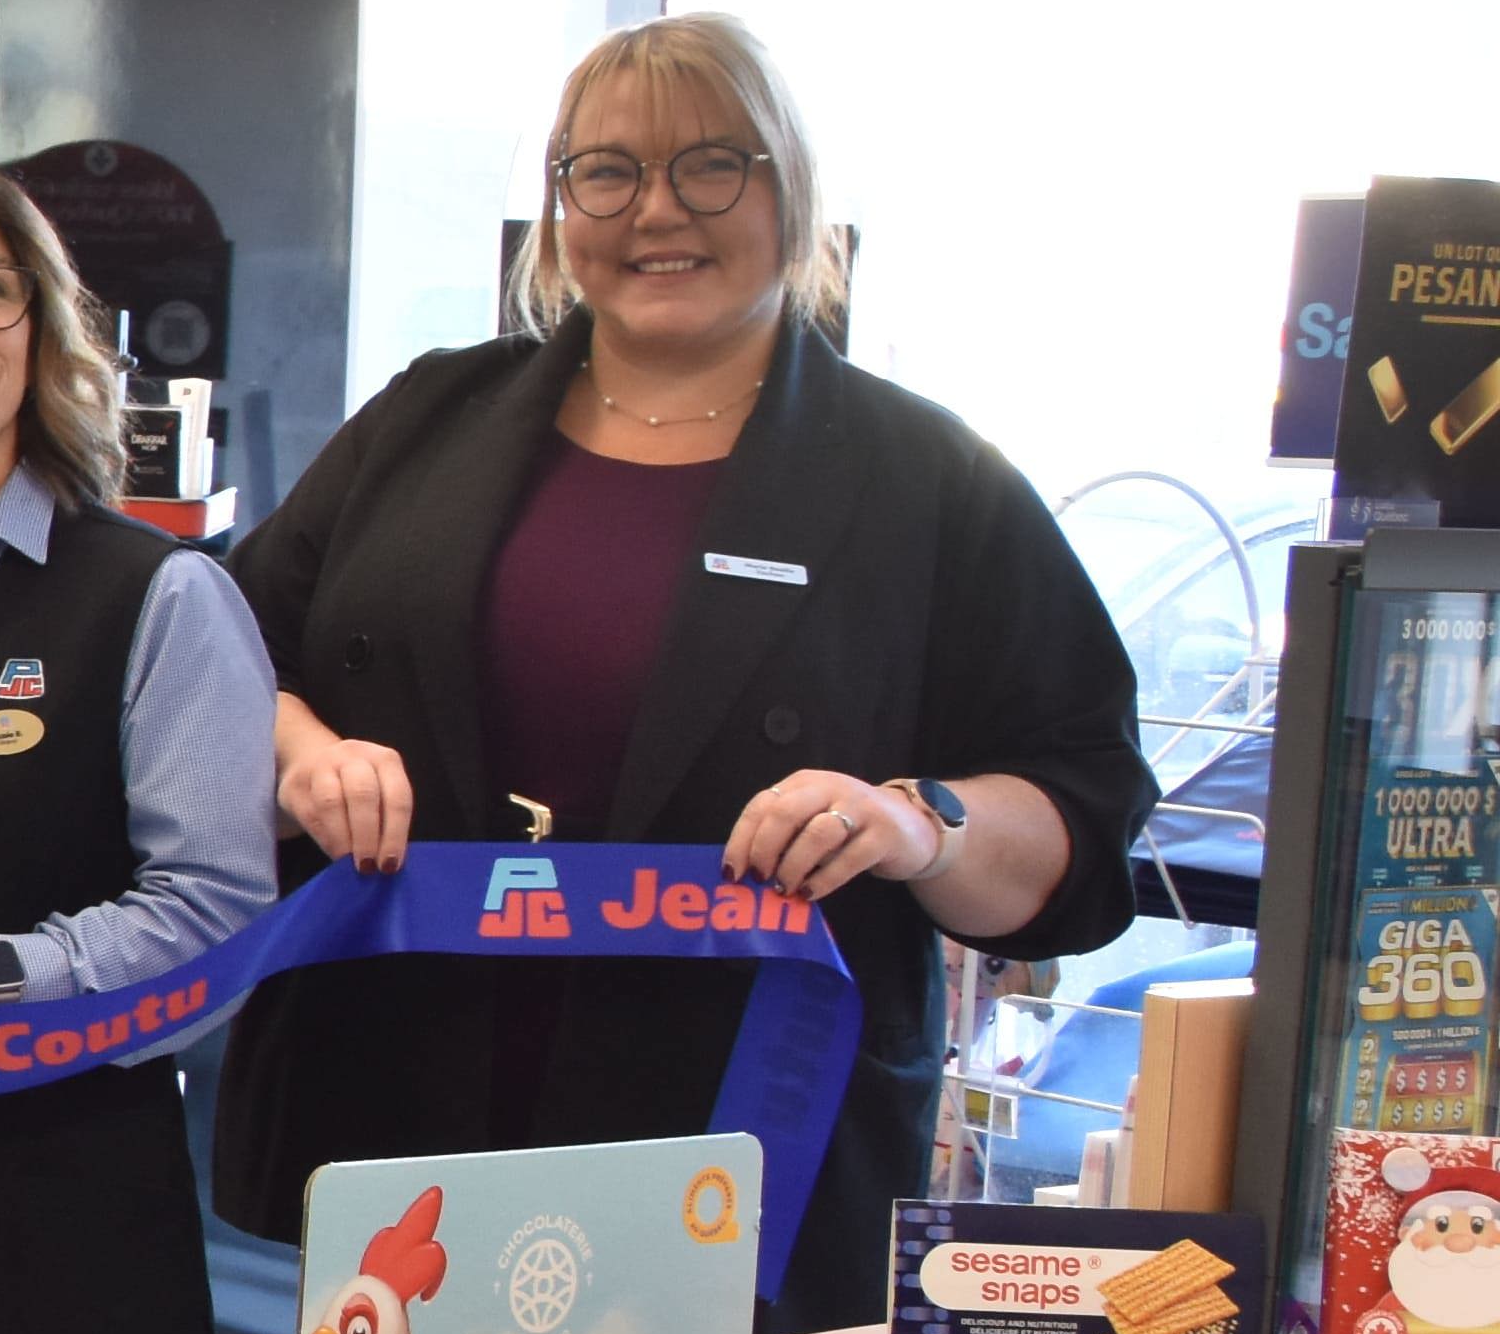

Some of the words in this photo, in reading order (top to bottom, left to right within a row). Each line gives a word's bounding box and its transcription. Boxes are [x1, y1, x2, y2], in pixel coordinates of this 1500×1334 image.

[1457, 246, 1482, 260] LOT
[1387, 817, 1475, 857] ULTRA
[601, 867, 812, 935] Jean
[1379, 919, 1473, 951] GIGA
[1358, 952, 1486, 1007] 360
[498, 1214, 594, 1269] CHOCOLATERIE
[951, 1252, 1081, 1277] sesame
[981, 1281, 1081, 1310] snaps
[1008, 1318, 1026, 1328] AND
